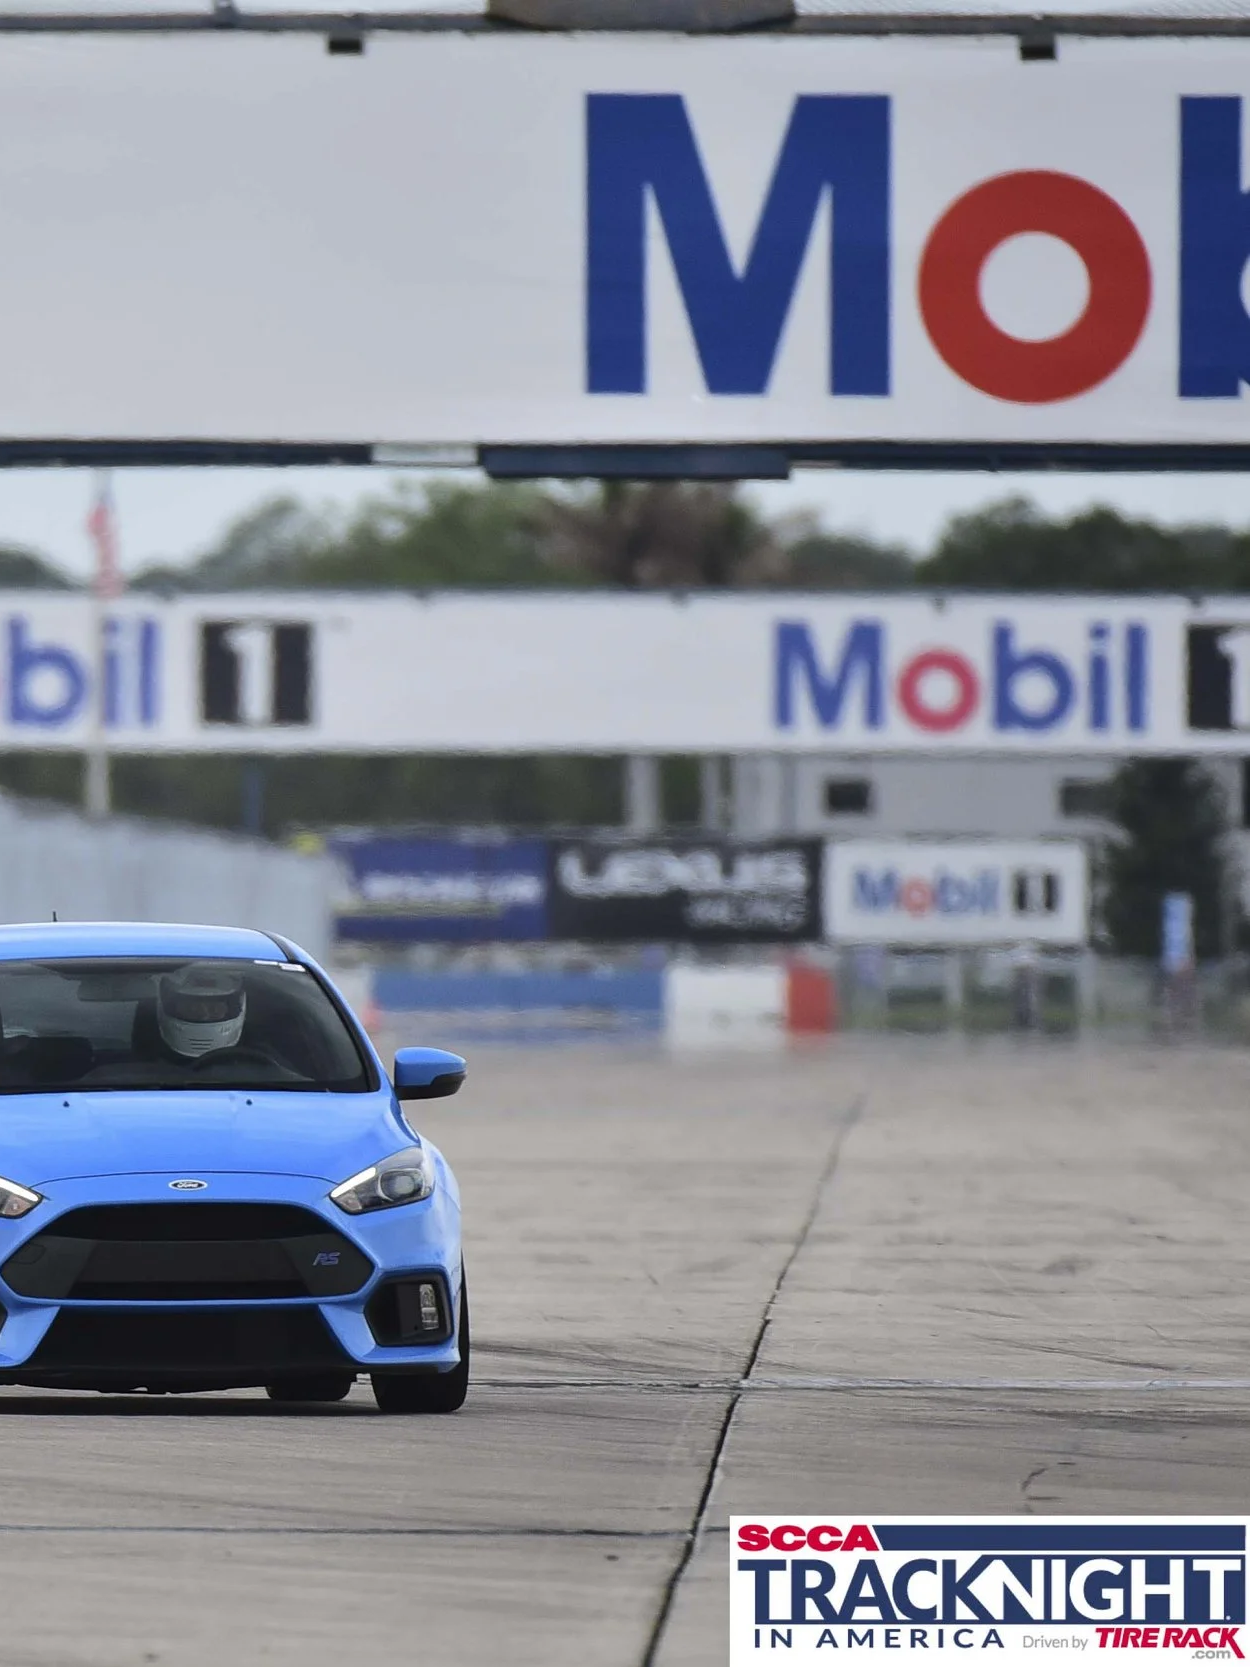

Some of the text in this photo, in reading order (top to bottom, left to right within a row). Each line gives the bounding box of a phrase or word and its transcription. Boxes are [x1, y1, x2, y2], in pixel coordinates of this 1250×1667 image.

[774, 619, 1148, 734] Mobil
[854, 868, 1000, 918] Mobil
[313, 1252, 341, 1266] RS
